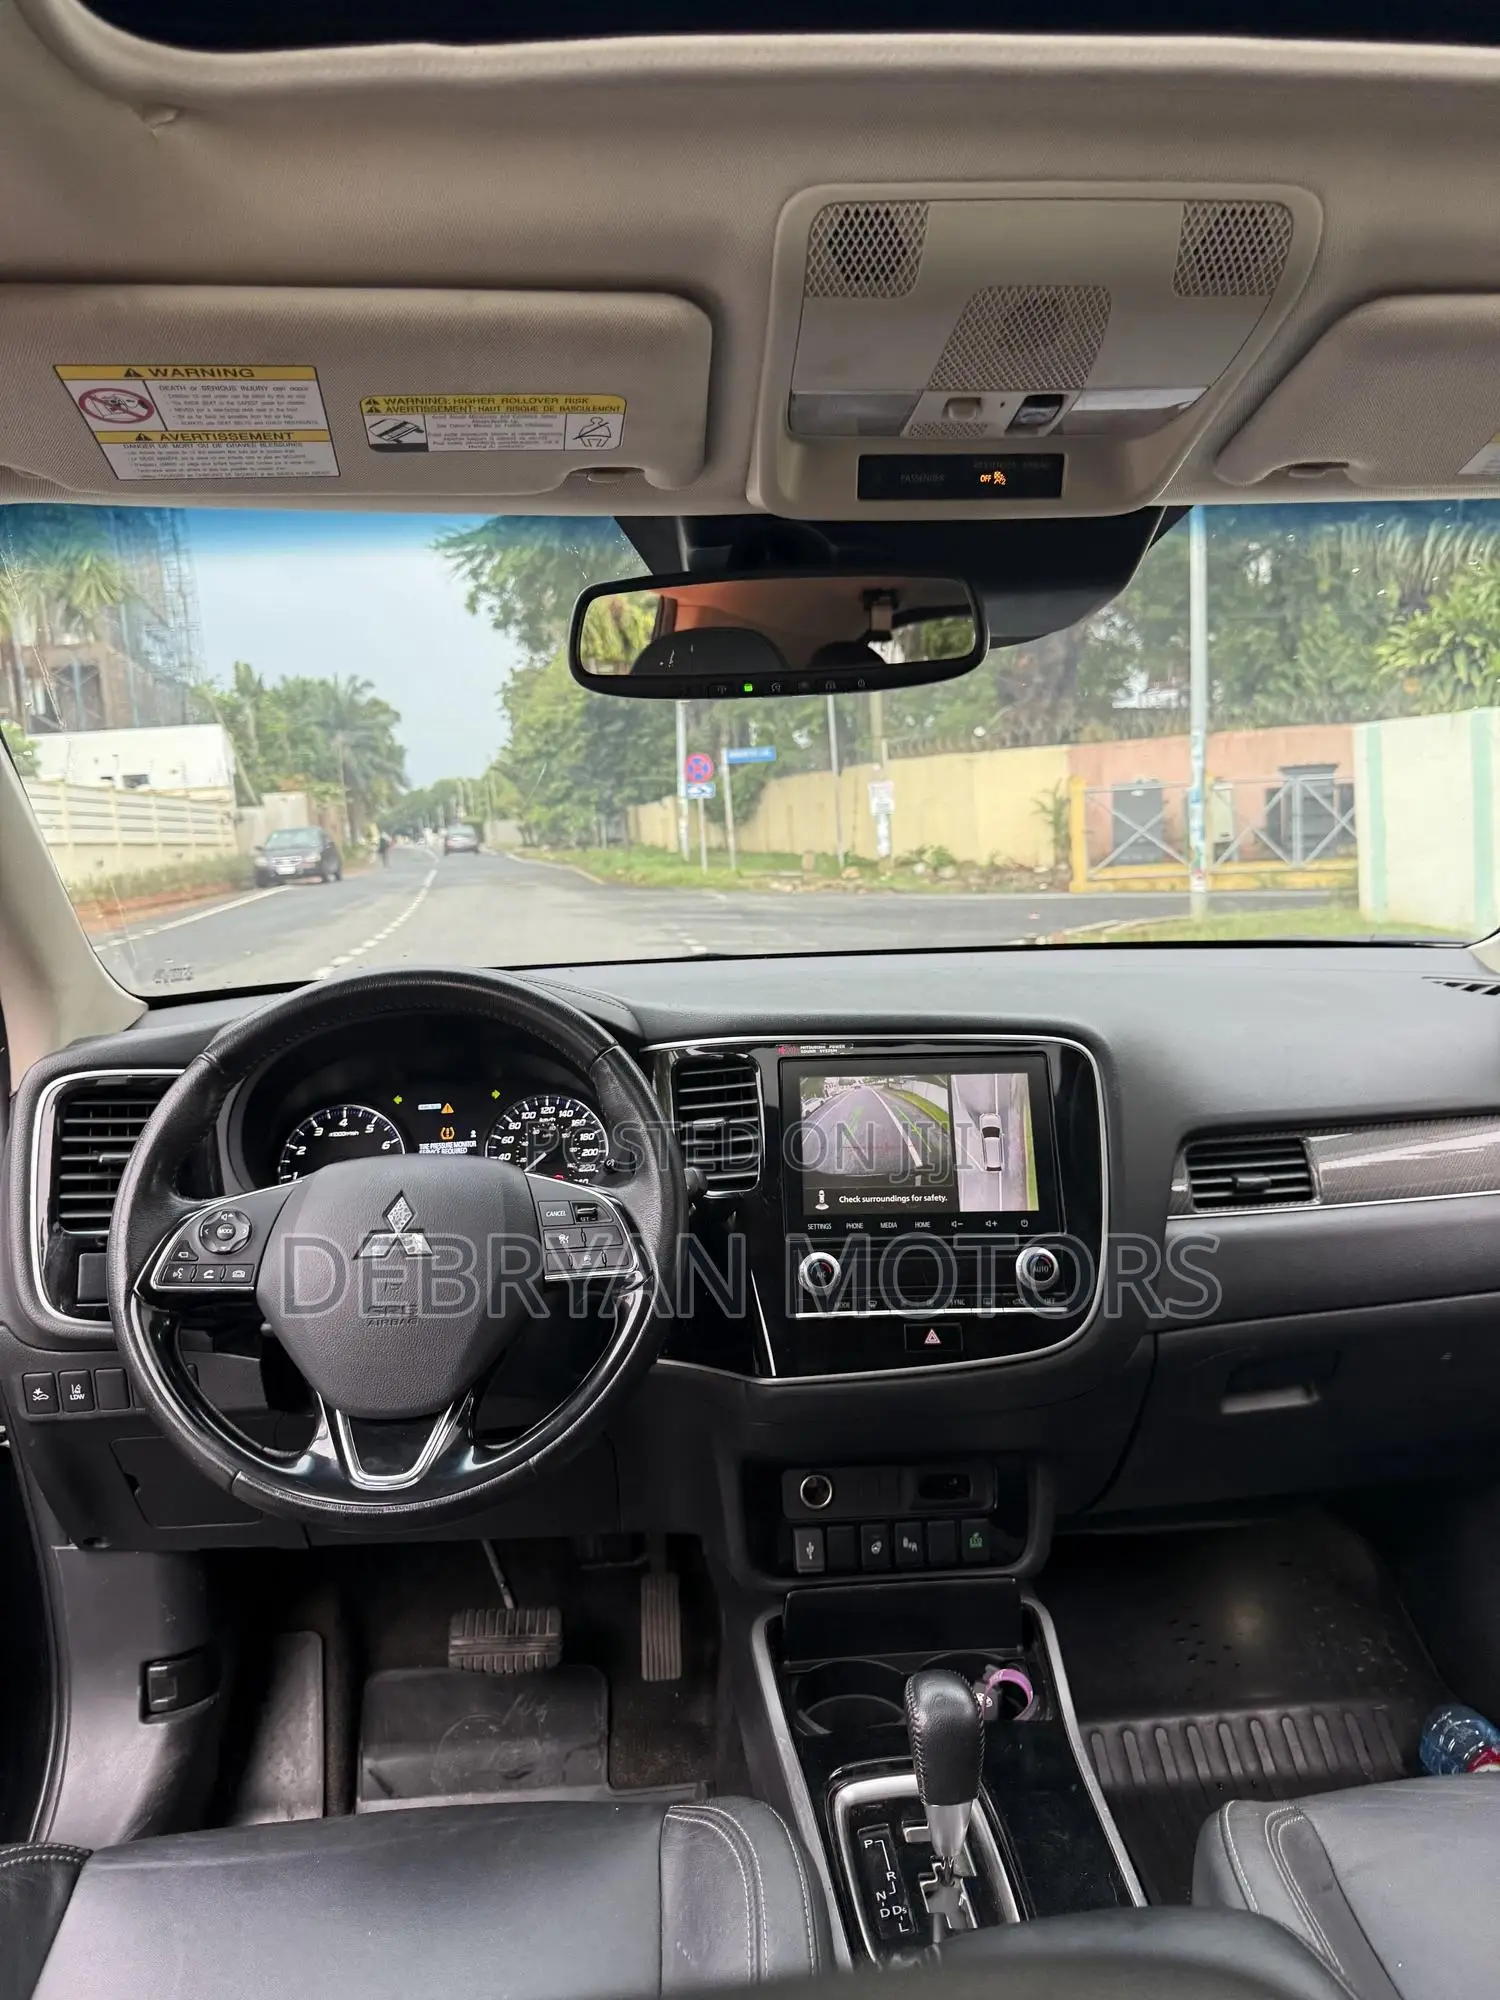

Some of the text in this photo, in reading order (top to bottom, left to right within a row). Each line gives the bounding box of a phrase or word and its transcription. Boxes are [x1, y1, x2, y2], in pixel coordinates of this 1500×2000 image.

[148, 368, 255, 378] WARNING
[160, 432, 294, 441] AVERTISSEMENT
[980, 474, 991, 483] OFF
[540, 1106, 555, 1114] 120
[559, 1110, 573, 1118] 140
[338, 1118, 348, 1127] 4
[508, 1122, 521, 1130] 80
[571, 1119, 586, 1127] 160
[314, 1127, 323, 1136] 3
[365, 1125, 374, 1133] 5
[501, 1136, 514, 1144] 60
[381, 1141, 390, 1149] 6
[296, 1146, 306, 1155] 2
[582, 1148, 598, 1156] 200
[579, 1164, 596, 1172] 220
[839, 1194, 948, 1204] Check surroundings for safety.
[864, 1840, 874, 1848] P
[886, 1871, 896, 1881] R
[876, 1891, 887, 1901] N
[880, 1908, 890, 1918] D
[899, 1923, 909, 1932] L
